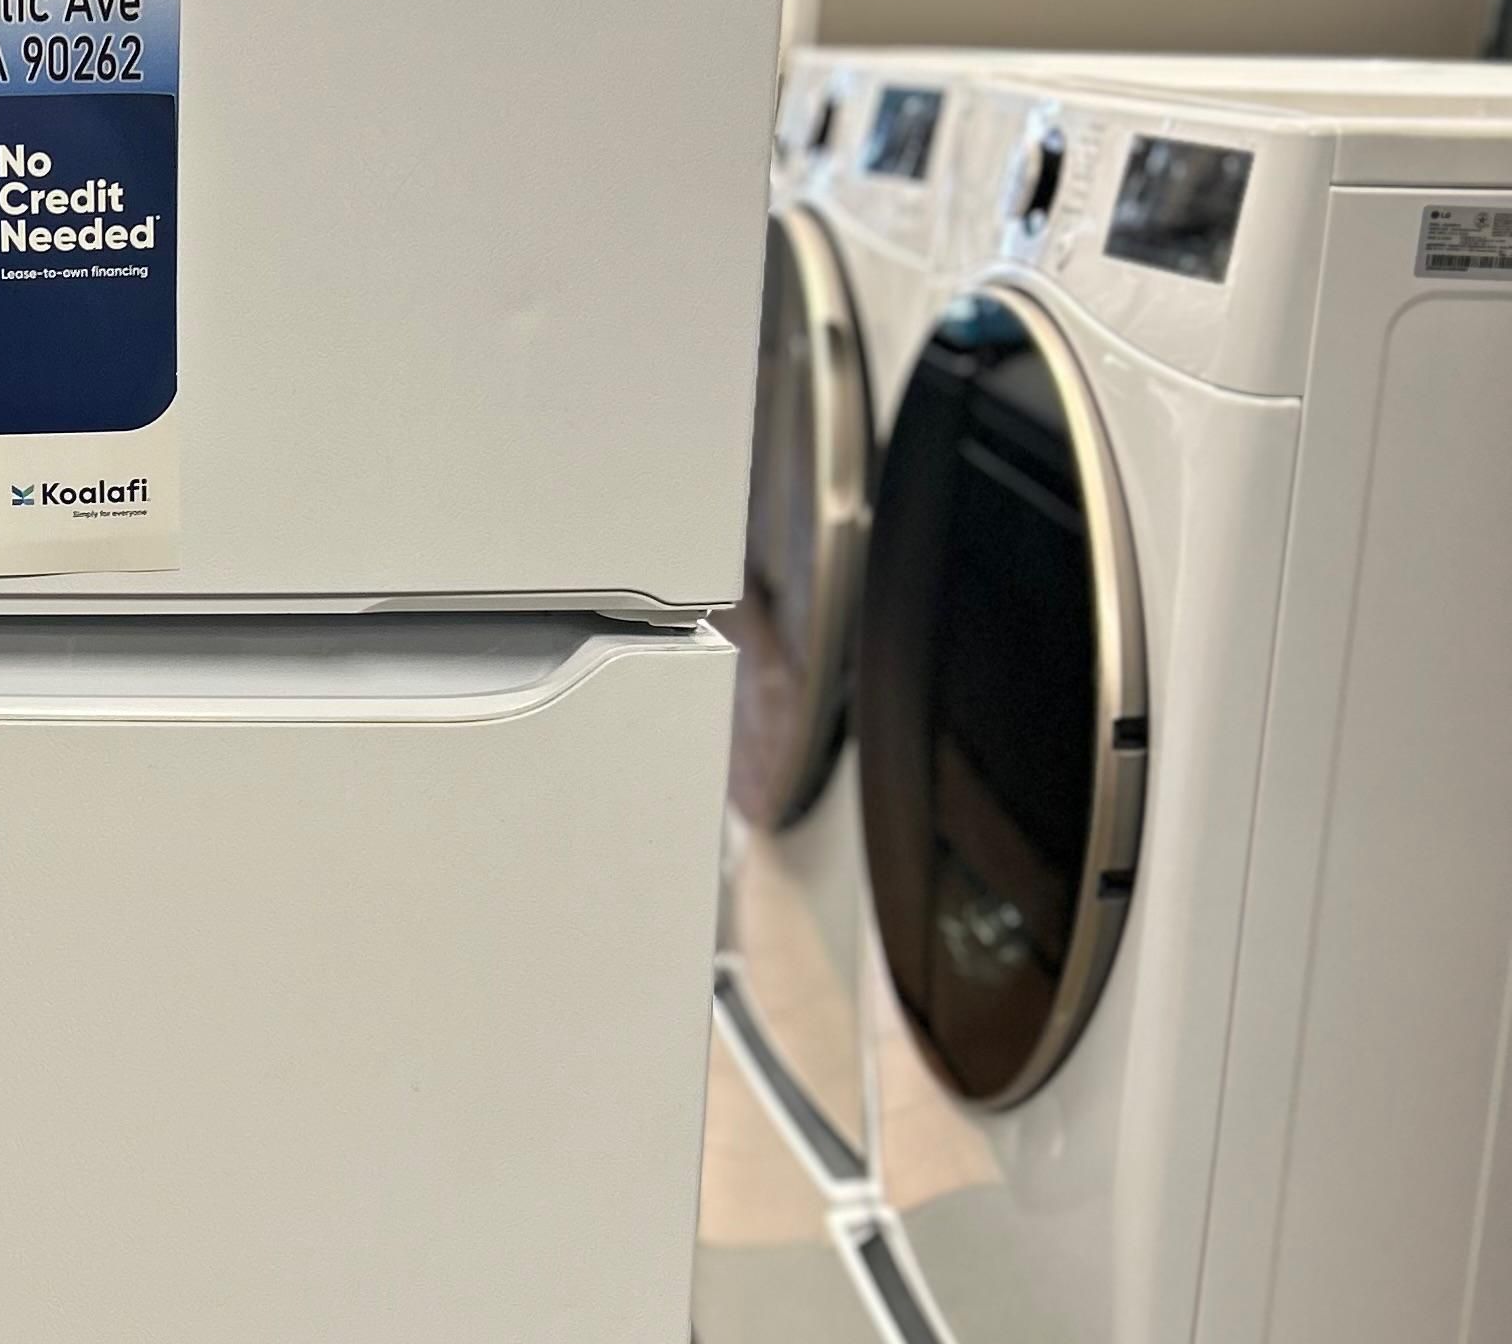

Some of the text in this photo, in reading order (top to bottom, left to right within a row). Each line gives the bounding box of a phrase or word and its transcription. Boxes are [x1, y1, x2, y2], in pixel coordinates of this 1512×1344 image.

[23, 36, 142, 82] 90262
[0, 179, 124, 215] Credit
[1, 264, 148, 280] Lease-to-own financing
[42, 479, 147, 505] Koalafi
[73, 510, 98, 518] Simply
[112, 509, 147, 517] everyone
